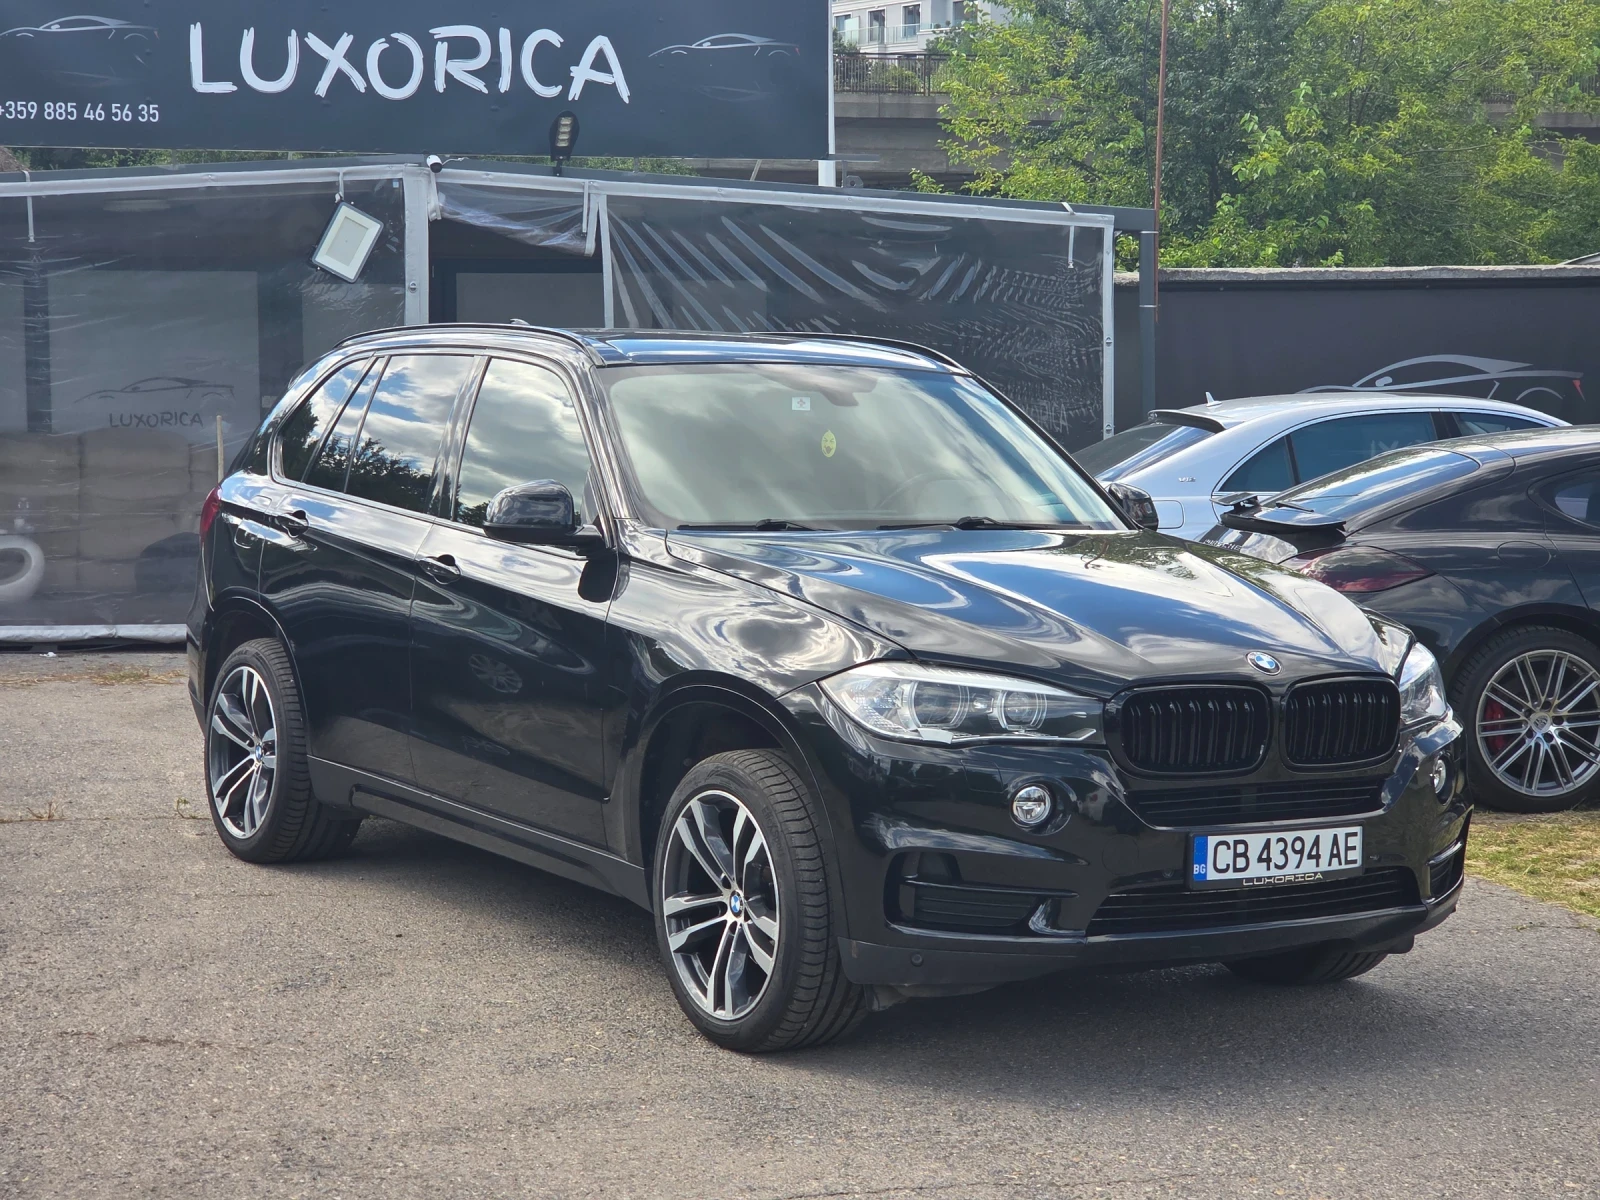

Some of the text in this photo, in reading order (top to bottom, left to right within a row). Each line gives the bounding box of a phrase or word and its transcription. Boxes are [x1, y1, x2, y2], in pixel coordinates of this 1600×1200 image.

[190, 22, 630, 103] LUXORICA
[44, 102, 77, 120] 885
[84, 103, 105, 121] 46
[111, 103, 132, 122] 56
[138, 104, 159, 122] 35
[108, 411, 204, 428] LUXORICA
[1212, 831, 1358, 874] CB 4394 AE
[1193, 863, 1206, 875] BG
[1242, 872, 1323, 886] LUXORICA
